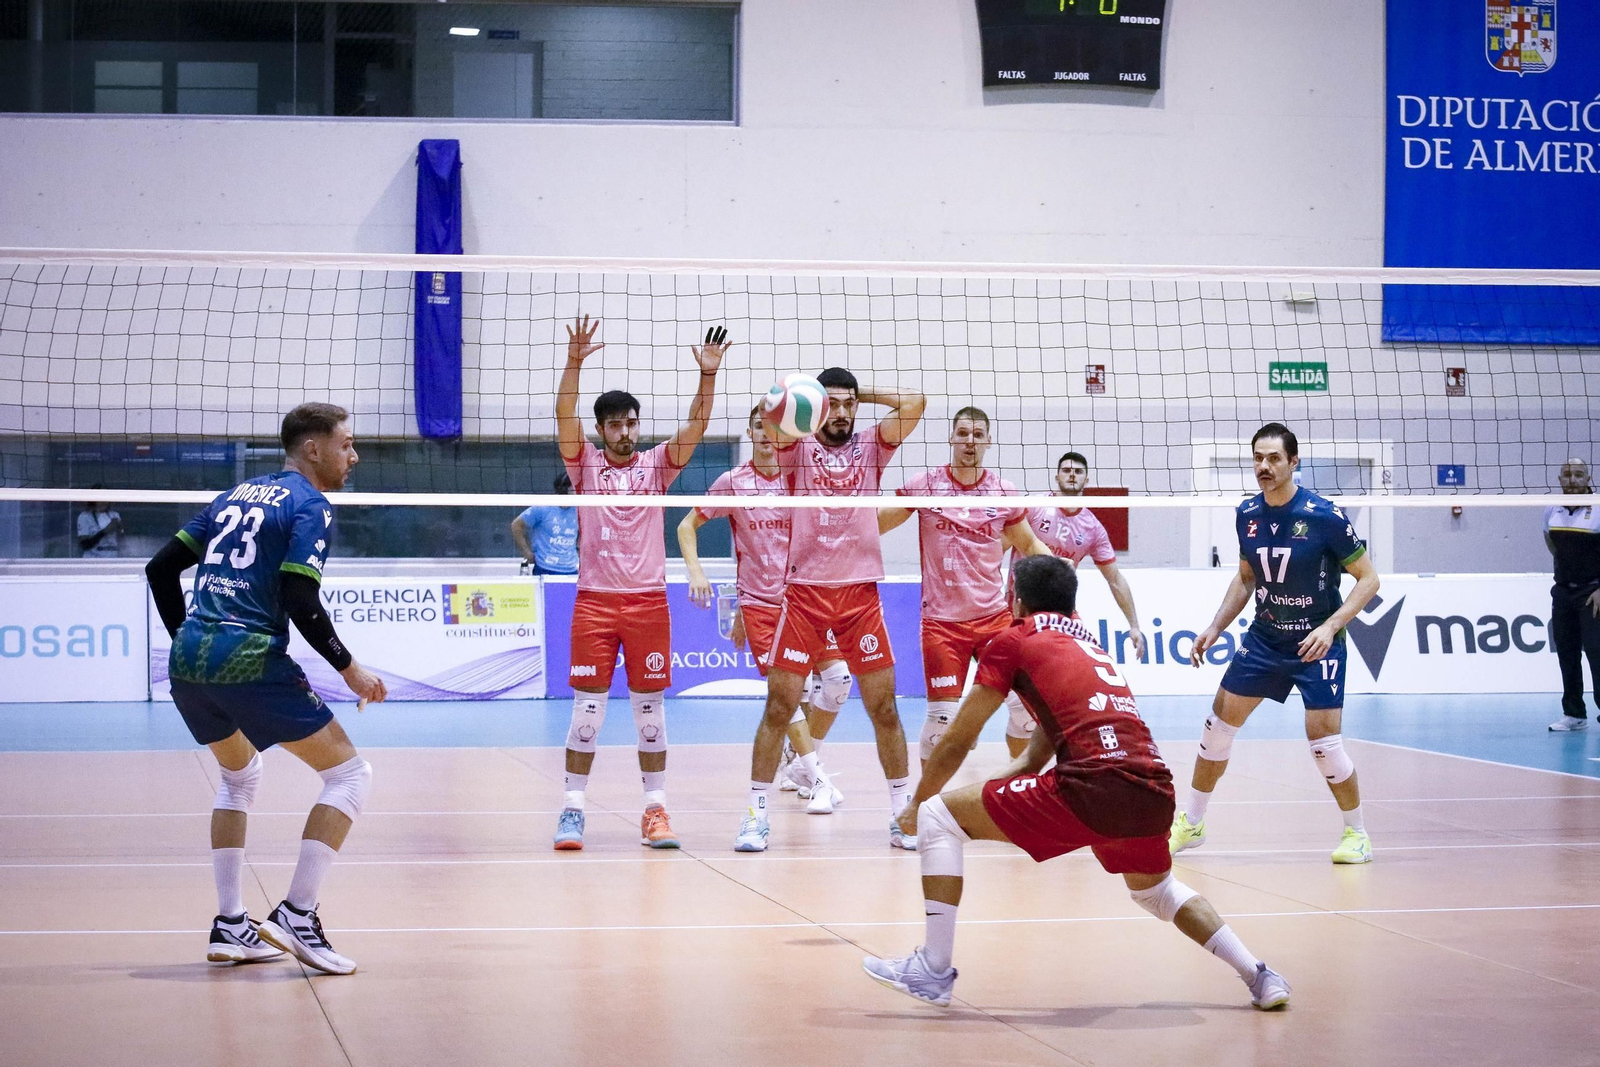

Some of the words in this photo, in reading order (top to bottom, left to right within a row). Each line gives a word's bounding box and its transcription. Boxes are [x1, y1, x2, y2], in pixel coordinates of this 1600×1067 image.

[1120, 16, 1161, 25] MONDO
[998, 70, 1026, 79] FALTAS
[1053, 72, 1090, 81] JUGADOR
[1119, 73, 1147, 82] FALTAS
[1401, 137, 1453, 169] DE
[1464, 139, 1600, 174] ALMER
[204, 505, 265, 570] 23
[1055, 522, 1070, 542] 12
[1256, 547, 1292, 583] 17
[322, 588, 436, 604] VIOLENCIA
[1270, 594, 1313, 609] Unicaja
[351, 605, 437, 623] GÉNERO
[0, 624, 130, 657] osan
[1415, 614, 1556, 654] mac
[1073, 638, 1127, 687] 5
[1319, 659, 1339, 680] 17
[1009, 777, 1037, 793] 5
